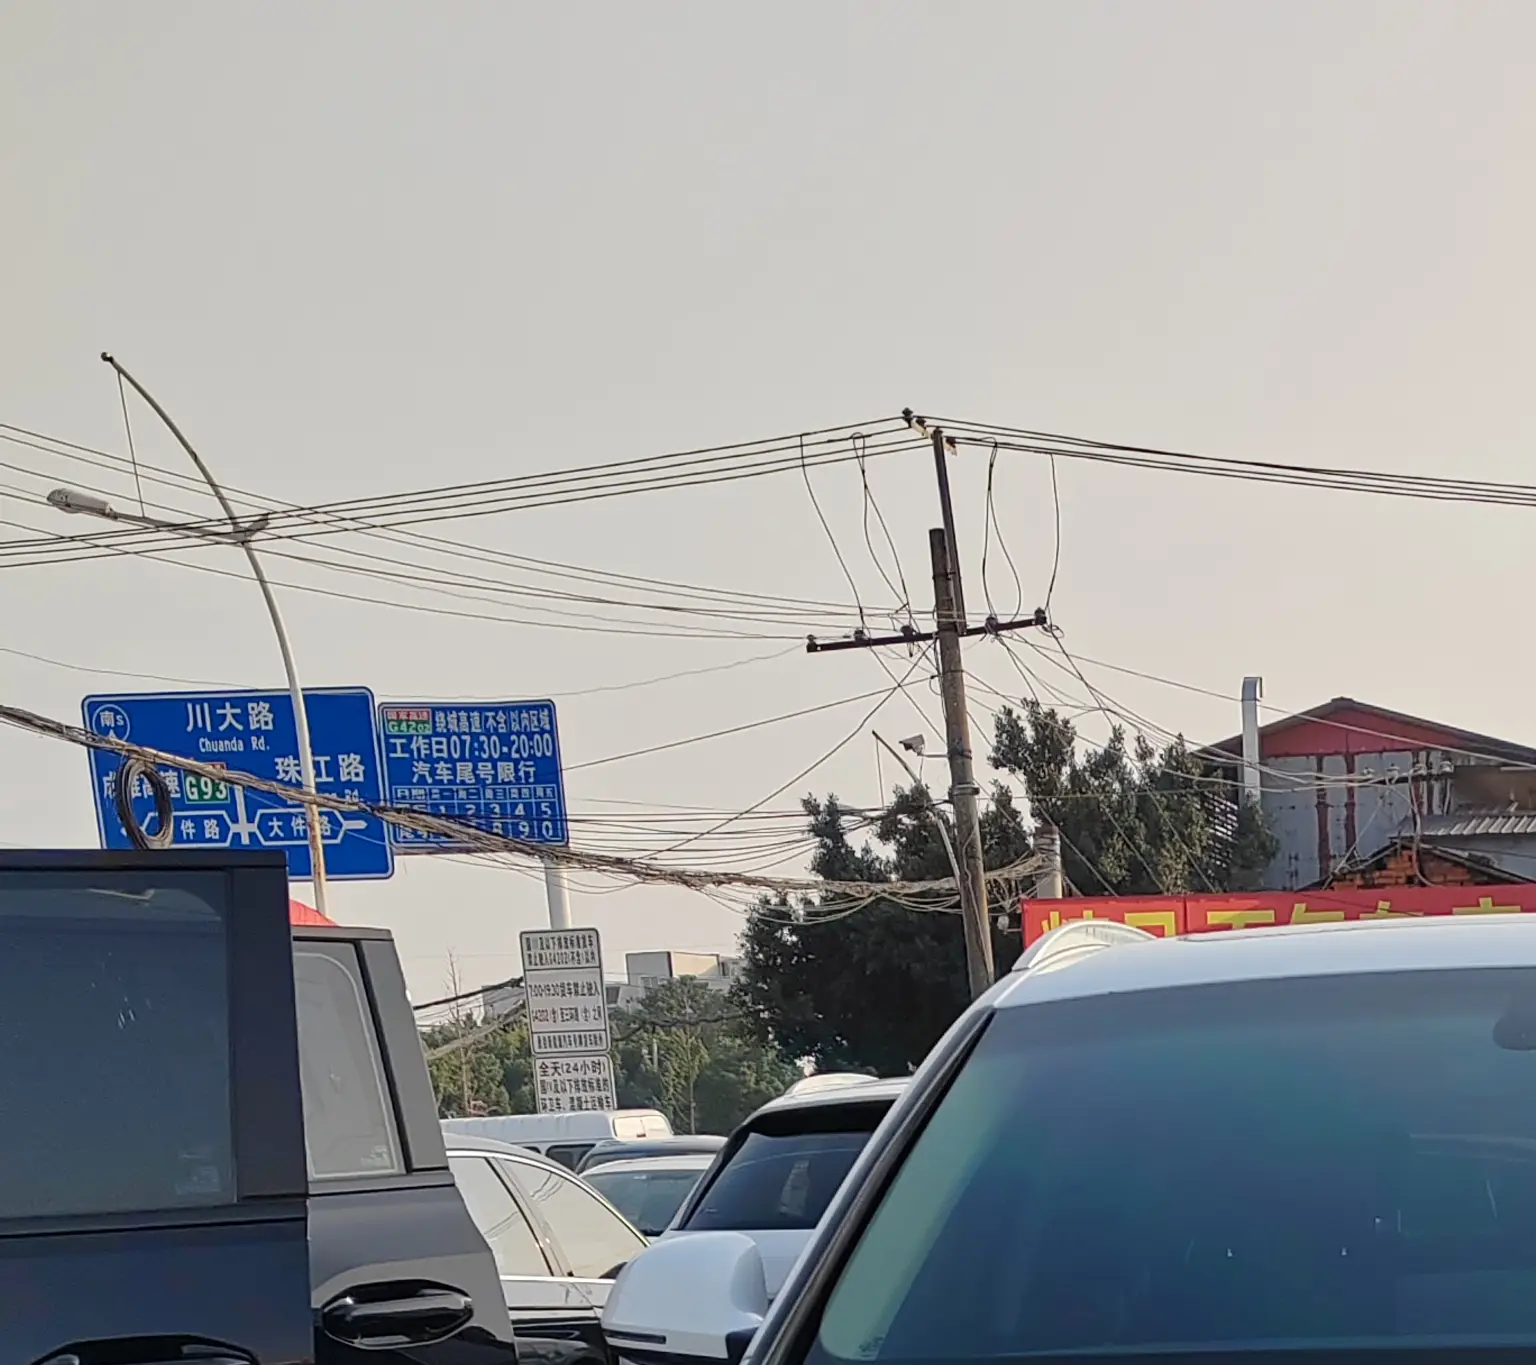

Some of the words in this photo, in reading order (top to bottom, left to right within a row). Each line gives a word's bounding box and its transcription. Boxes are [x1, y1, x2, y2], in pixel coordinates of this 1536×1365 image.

[186, 701, 274, 732] 川大路
[199, 737, 244, 753] Chuanda
[251, 736, 270, 751] Rd.
[412, 761, 536, 784] 汽车尾号限行
[185, 776, 227, 801] G93
[490, 803, 500, 817] 3
[514, 802, 525, 816] 4
[541, 802, 551, 818] 5
[519, 822, 529, 840] 9
[541, 822, 553, 840] 0
[539, 1059, 606, 1077] 全天(24小时)
